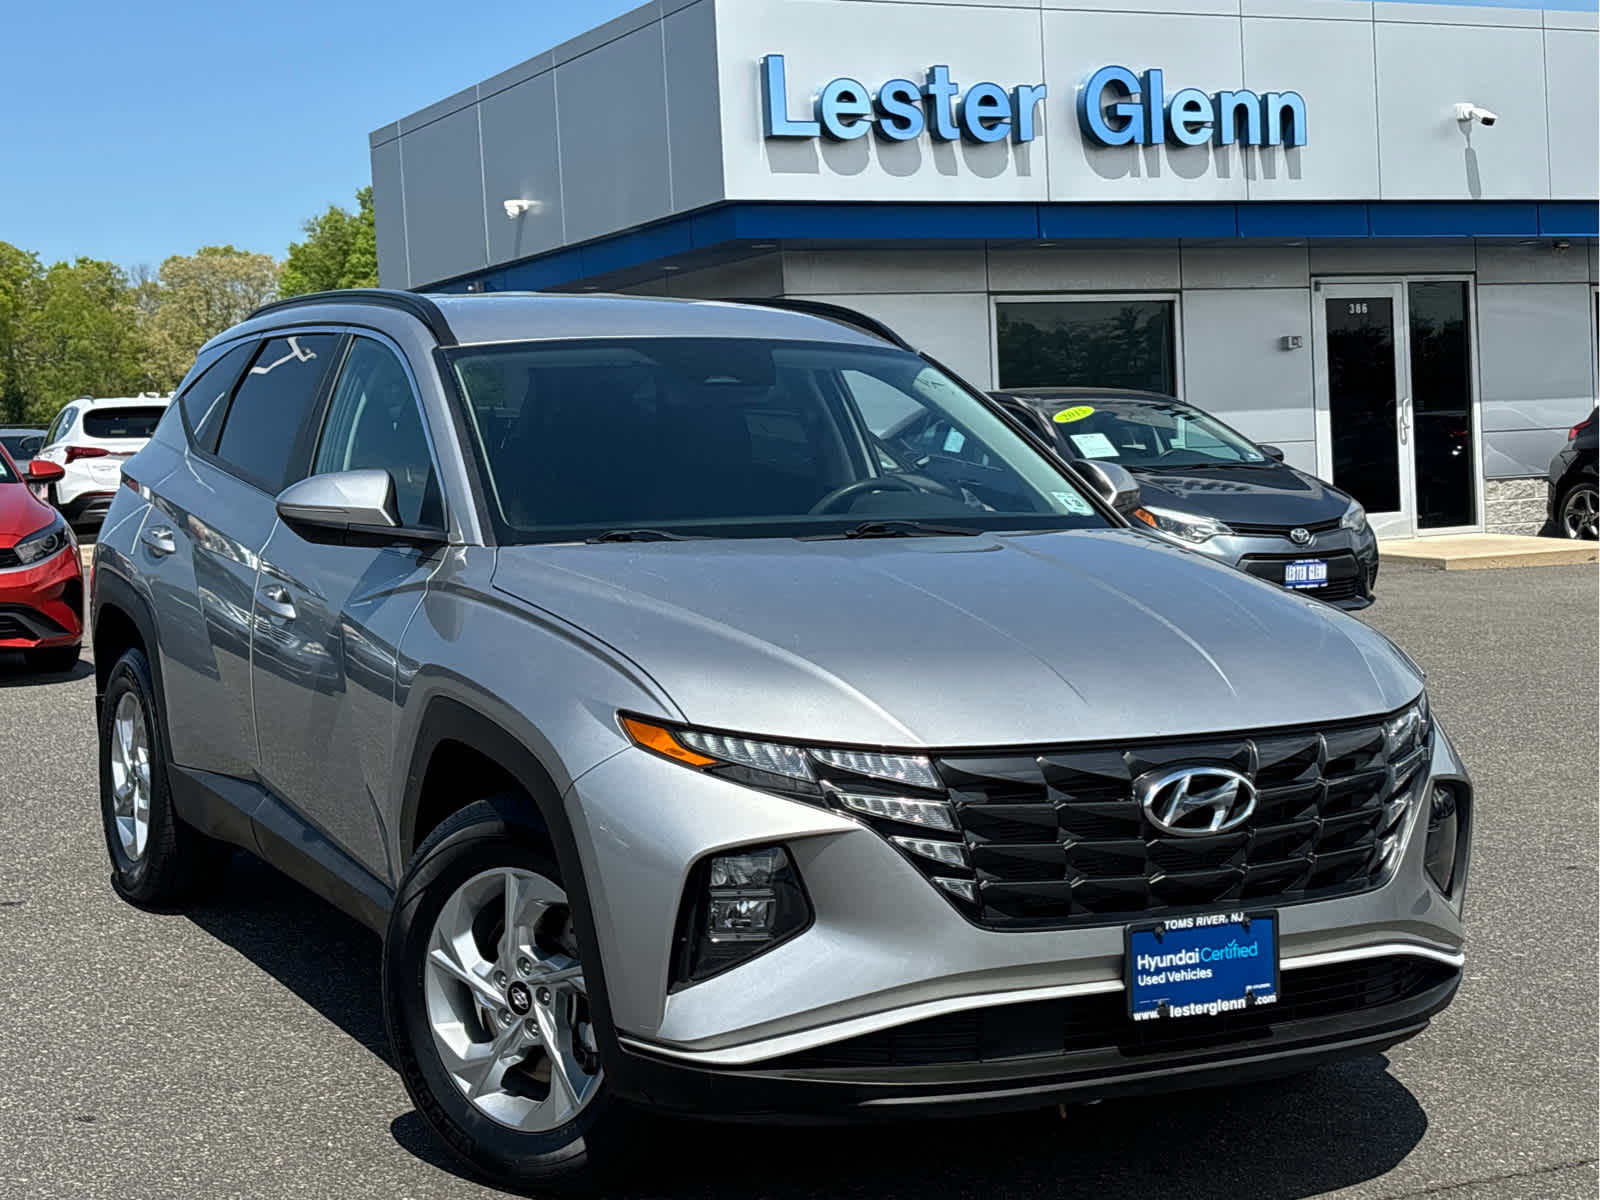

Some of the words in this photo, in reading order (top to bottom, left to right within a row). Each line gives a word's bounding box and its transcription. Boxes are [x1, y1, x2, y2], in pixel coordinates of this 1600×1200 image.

[760, 53, 1047, 142] Lester
[1079, 64, 1307, 147] Glenn
[1349, 303, 1368, 314] 386
[1164, 917, 1194, 930] TOMS
[1230, 912, 1244, 923] NJ
[1137, 948, 1200, 972] Hyundai
[1200, 939, 1258, 962] Certified
[1138, 972, 1166, 986] Used
[1167, 967, 1213, 983] Vehicles
[1169, 998, 1246, 1018] lesterglenn
